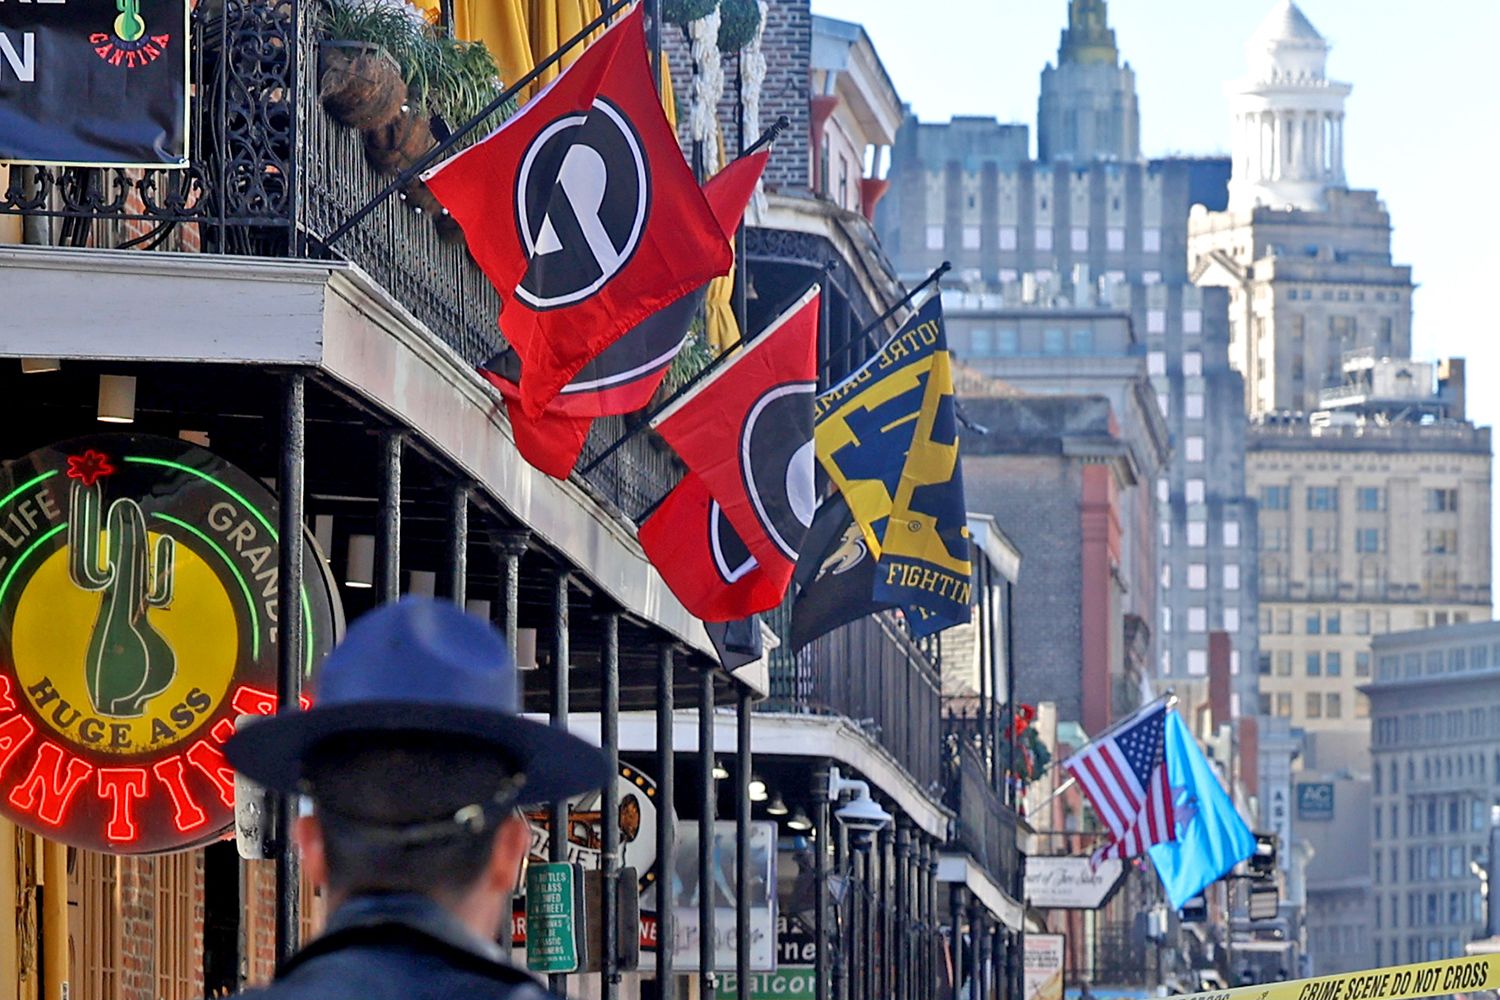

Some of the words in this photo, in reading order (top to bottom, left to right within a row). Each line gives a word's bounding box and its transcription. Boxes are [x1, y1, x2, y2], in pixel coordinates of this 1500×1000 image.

[88, 33, 170, 67] CANTINA
[0, 488, 61, 549] LIFE
[207, 502, 278, 643] GRAND
[27, 676, 132, 749] HUGE
[150, 687, 211, 744] ASS
[1344, 974, 1390, 1000] SCENE
[1390, 971, 1412, 995] DO
[1412, 968, 1442, 993] NOT
[1443, 961, 1489, 990] CROSS
